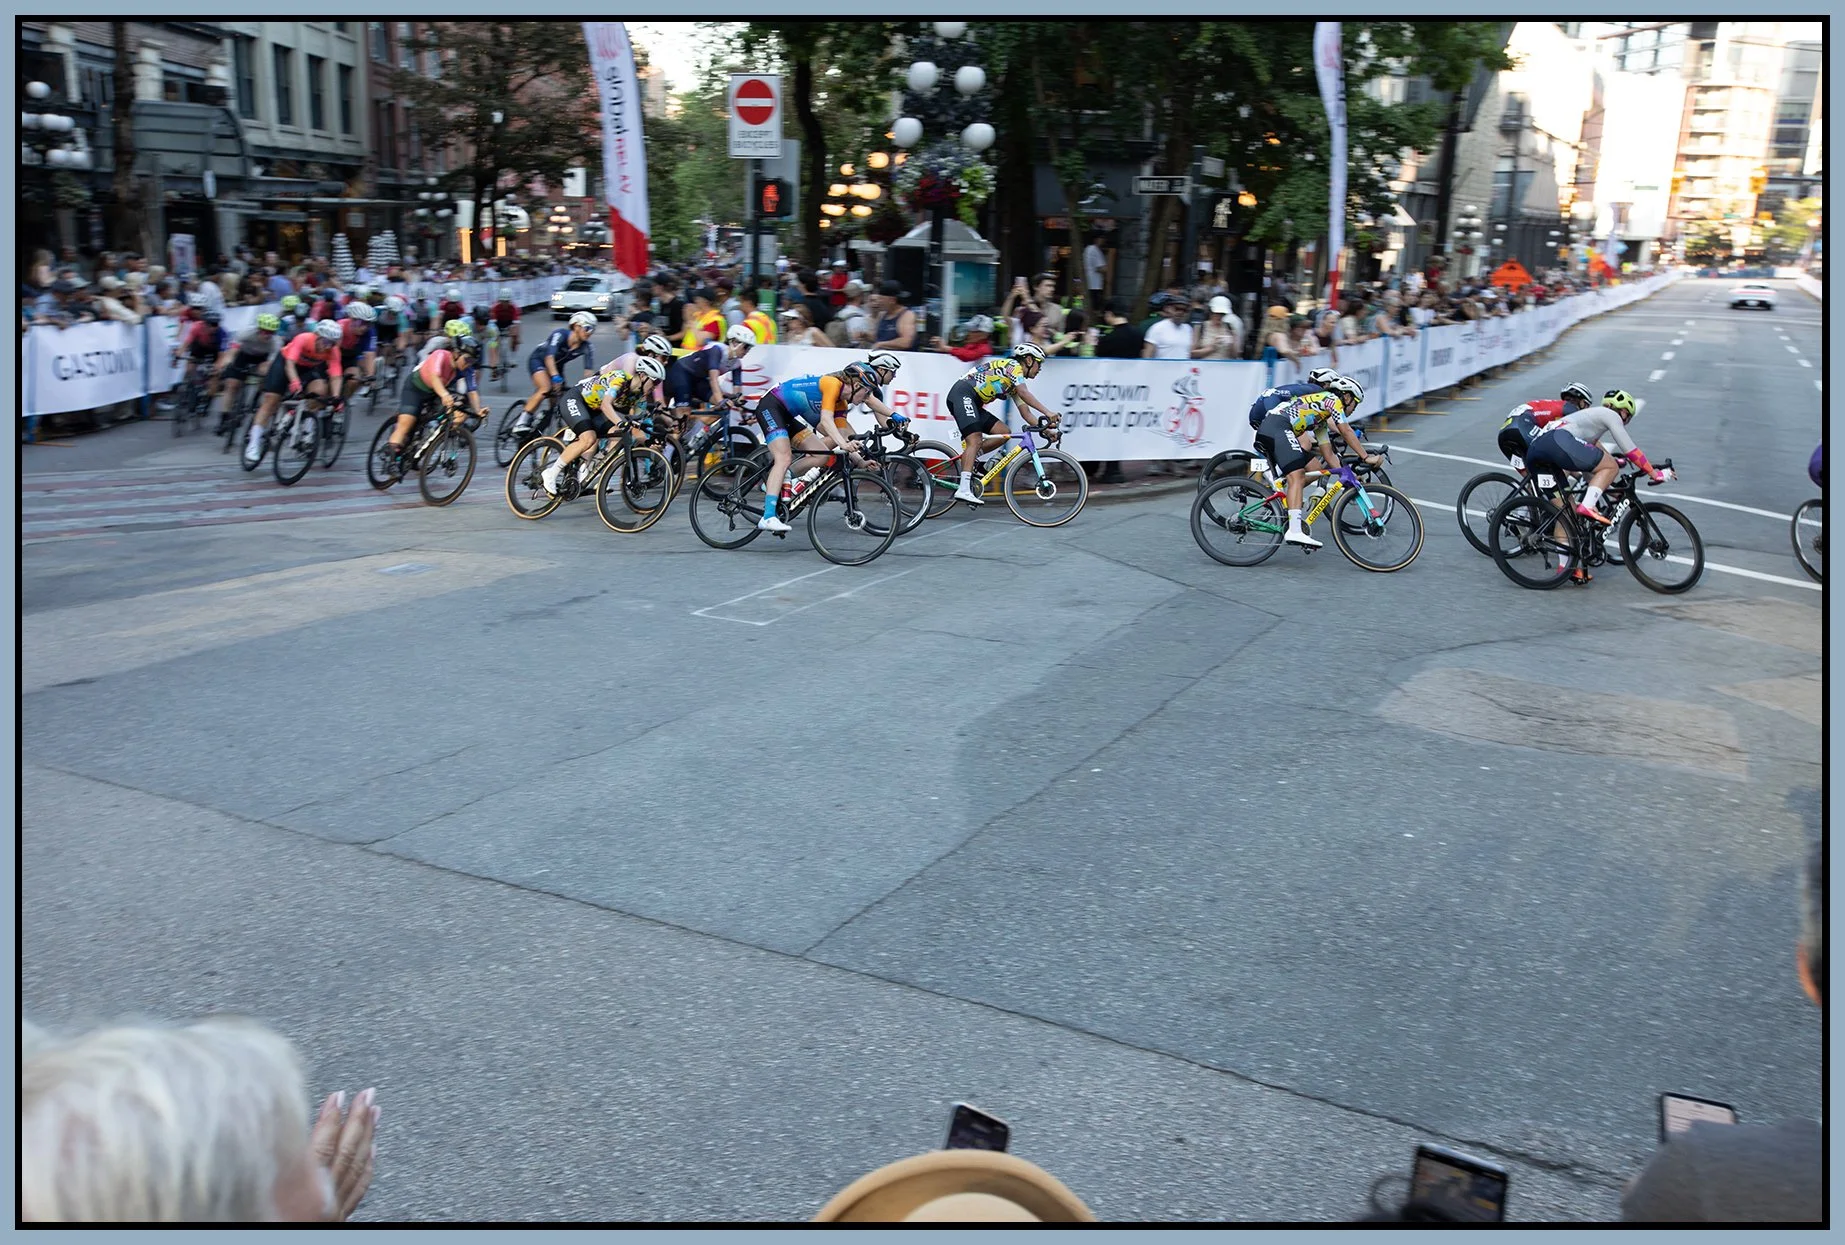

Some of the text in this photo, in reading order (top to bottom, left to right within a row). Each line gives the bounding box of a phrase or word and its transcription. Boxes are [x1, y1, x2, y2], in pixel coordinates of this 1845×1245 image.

[52, 347, 138, 382] GASTOWN
[893, 389, 955, 421] REL
[1061, 380, 1150, 407] gastown
[1061, 404, 1164, 434] grand prix
[1255, 462, 1263, 470] 21
[1542, 478, 1551, 487] 33
[1308, 484, 1339, 522] cannondale
